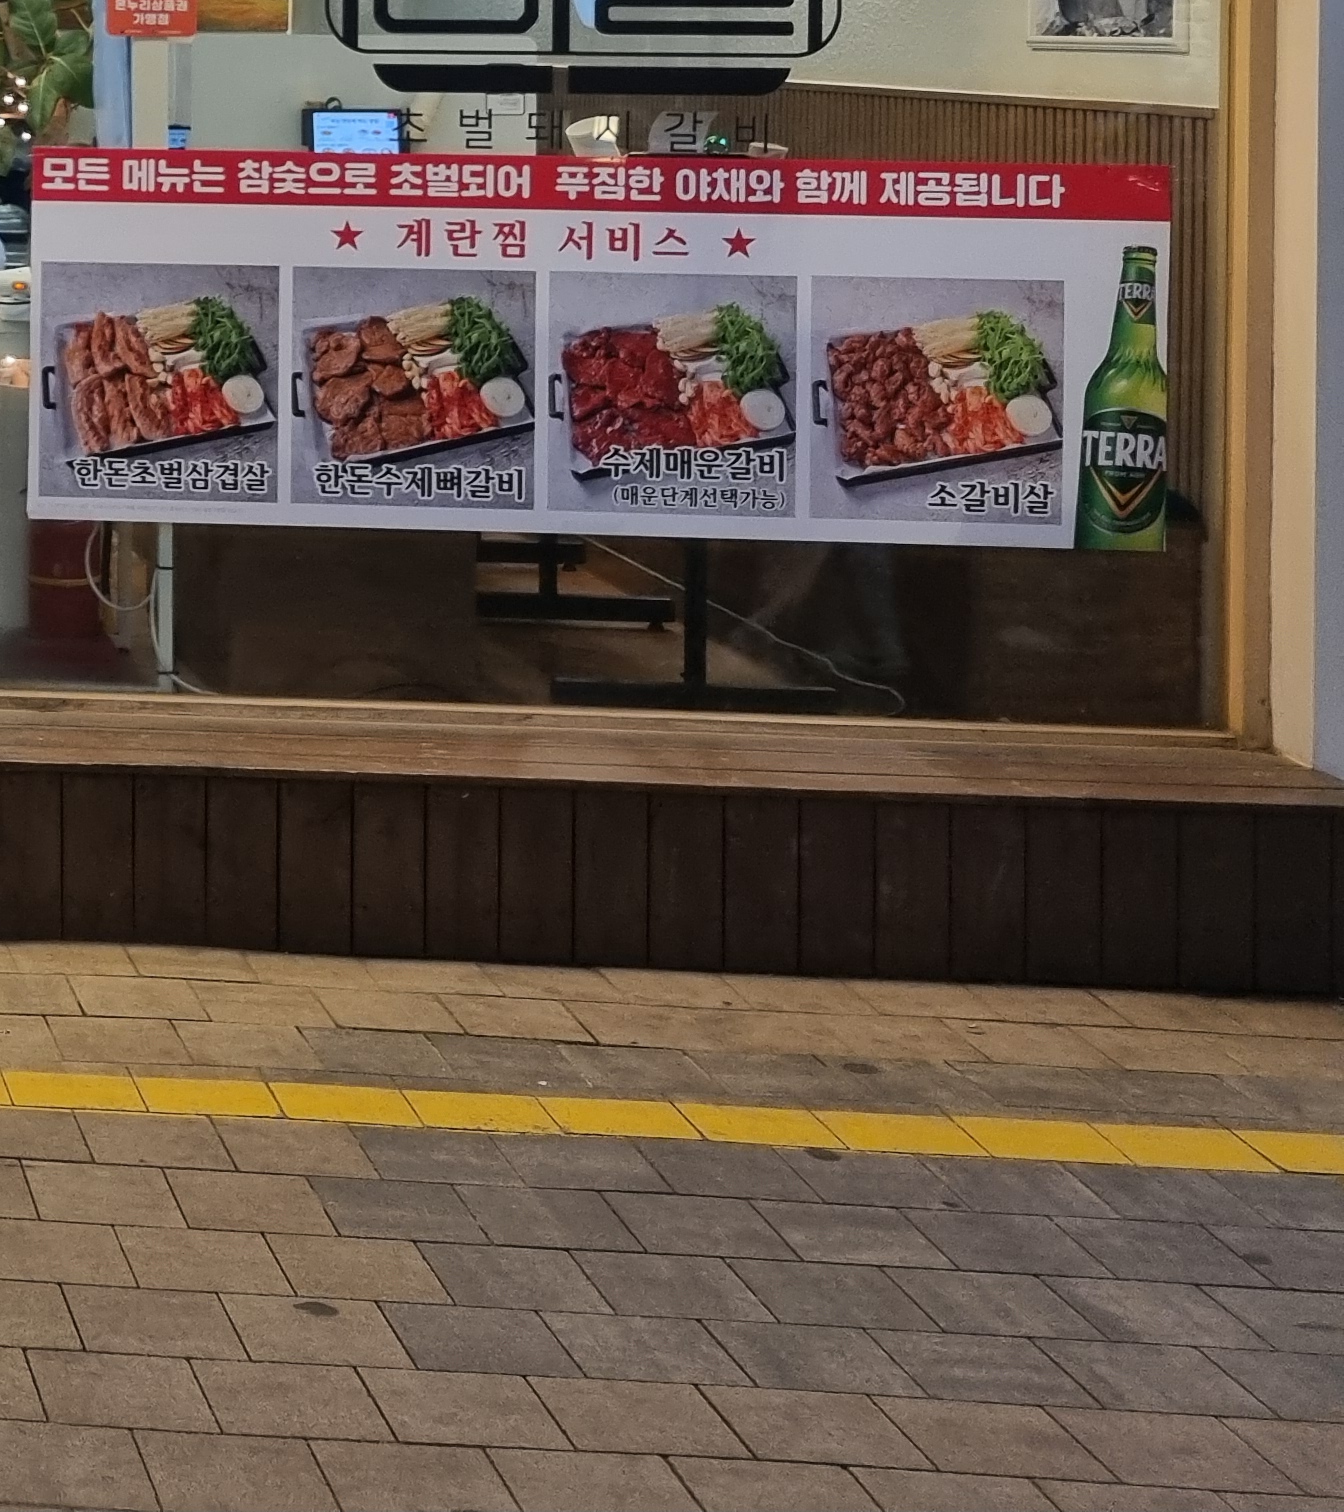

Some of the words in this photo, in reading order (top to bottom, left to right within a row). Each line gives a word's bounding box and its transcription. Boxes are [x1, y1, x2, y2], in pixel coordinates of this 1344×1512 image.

[41, 157, 111, 193] 모든
[122, 158, 226, 195] 메뉴는
[237, 160, 378, 197] 참숯으로
[389, 162, 531, 200] 초벌되어
[555, 165, 665, 203] 푸짐한
[675, 167, 784, 205] 야채와
[795, 169, 868, 206] 함께
[879, 170, 1066, 209] 제공됩니다
[395, 217, 528, 260] 계란찜
[559, 220, 691, 263] 서비스
[601, 447, 787, 484] 수제매운갈비
[1082, 429, 1167, 472] TERRA
[74, 457, 271, 494] 한돈초벌삼겹살
[314, 465, 526, 502] 한돈수제뼈갈비
[612, 485, 786, 511] (매운단계선택가능)
[927, 481, 1054, 517] 소갈비살
